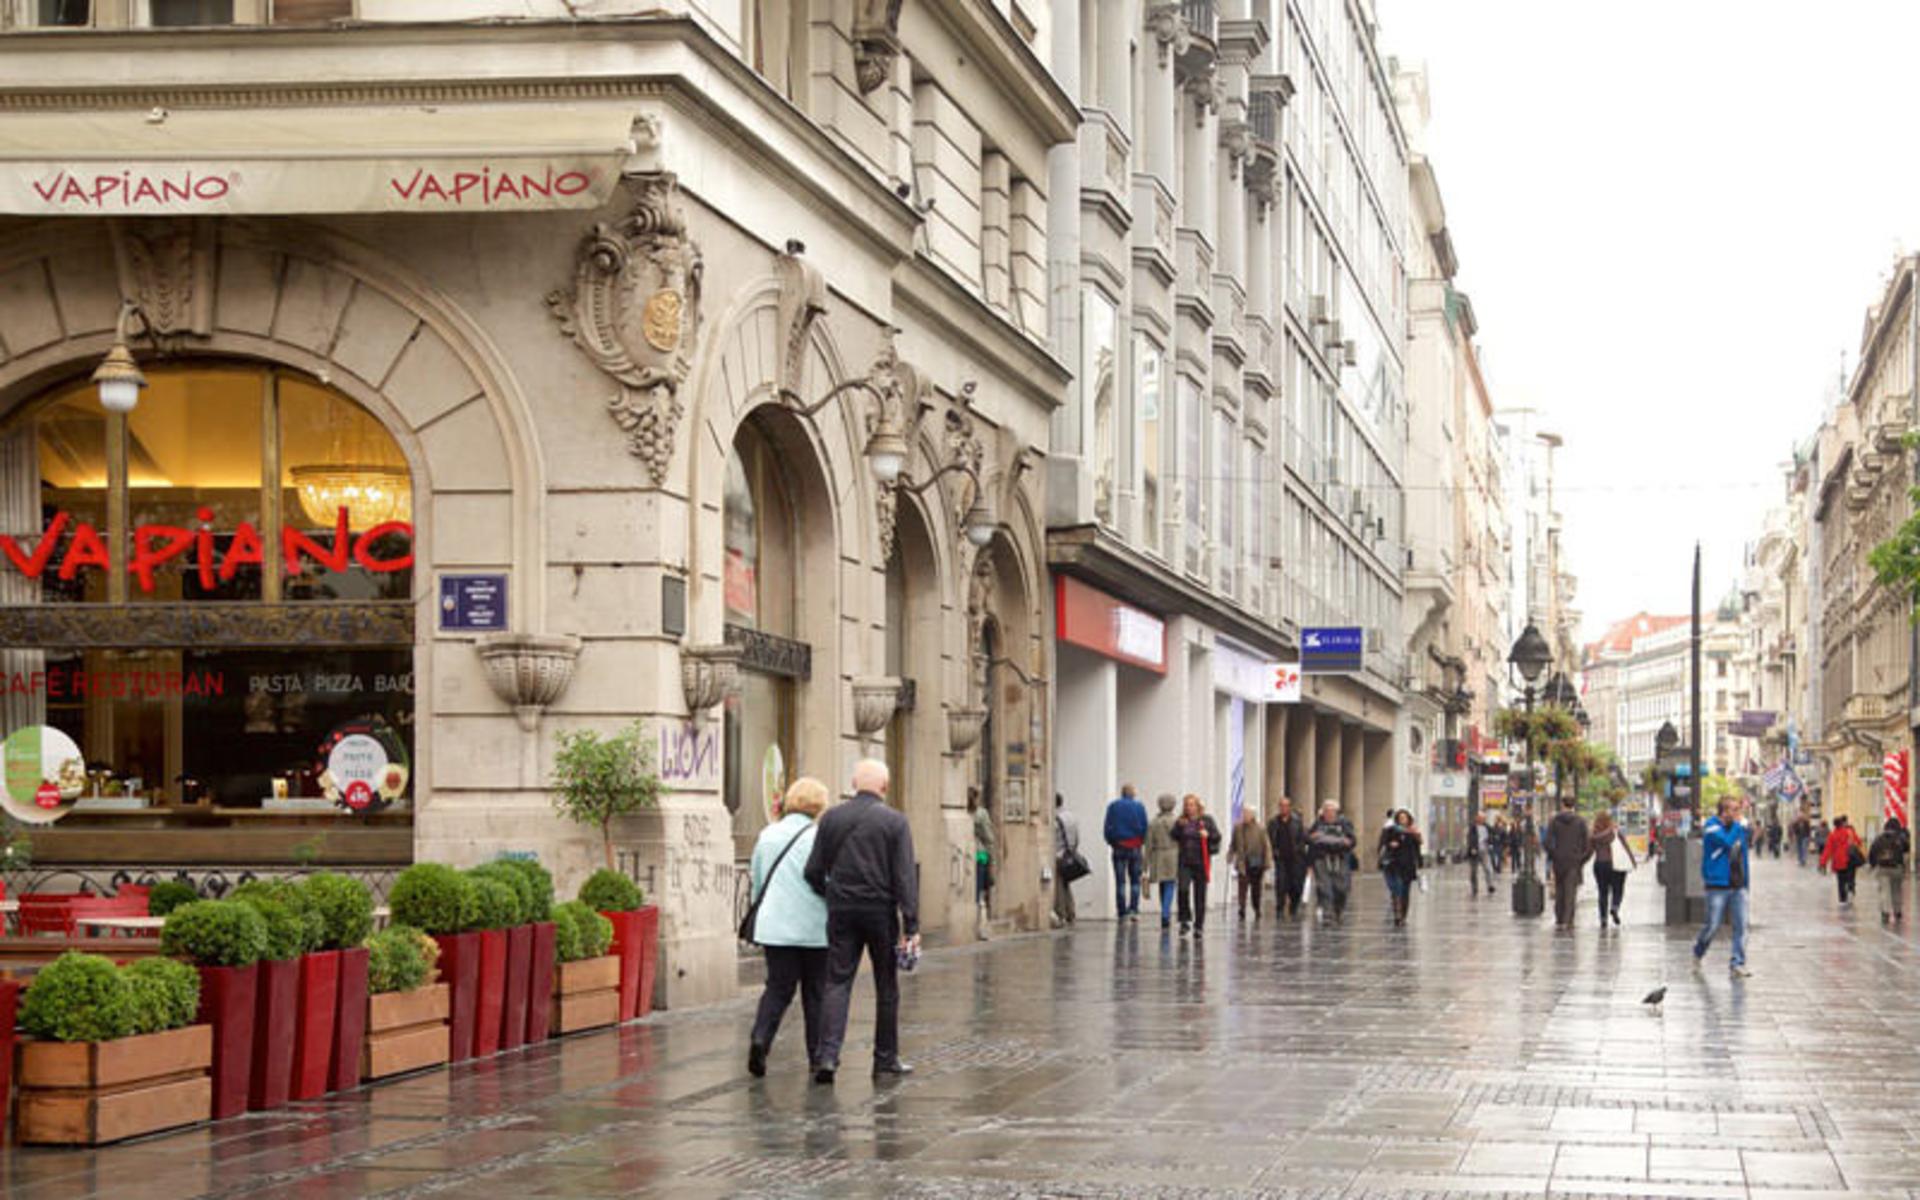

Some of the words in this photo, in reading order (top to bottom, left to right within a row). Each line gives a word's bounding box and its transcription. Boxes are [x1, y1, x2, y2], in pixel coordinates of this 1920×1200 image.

[71, 671, 225, 697] RESTORAN
[249, 673, 304, 693] PASTA
[314, 673, 365, 693] PIZZA
